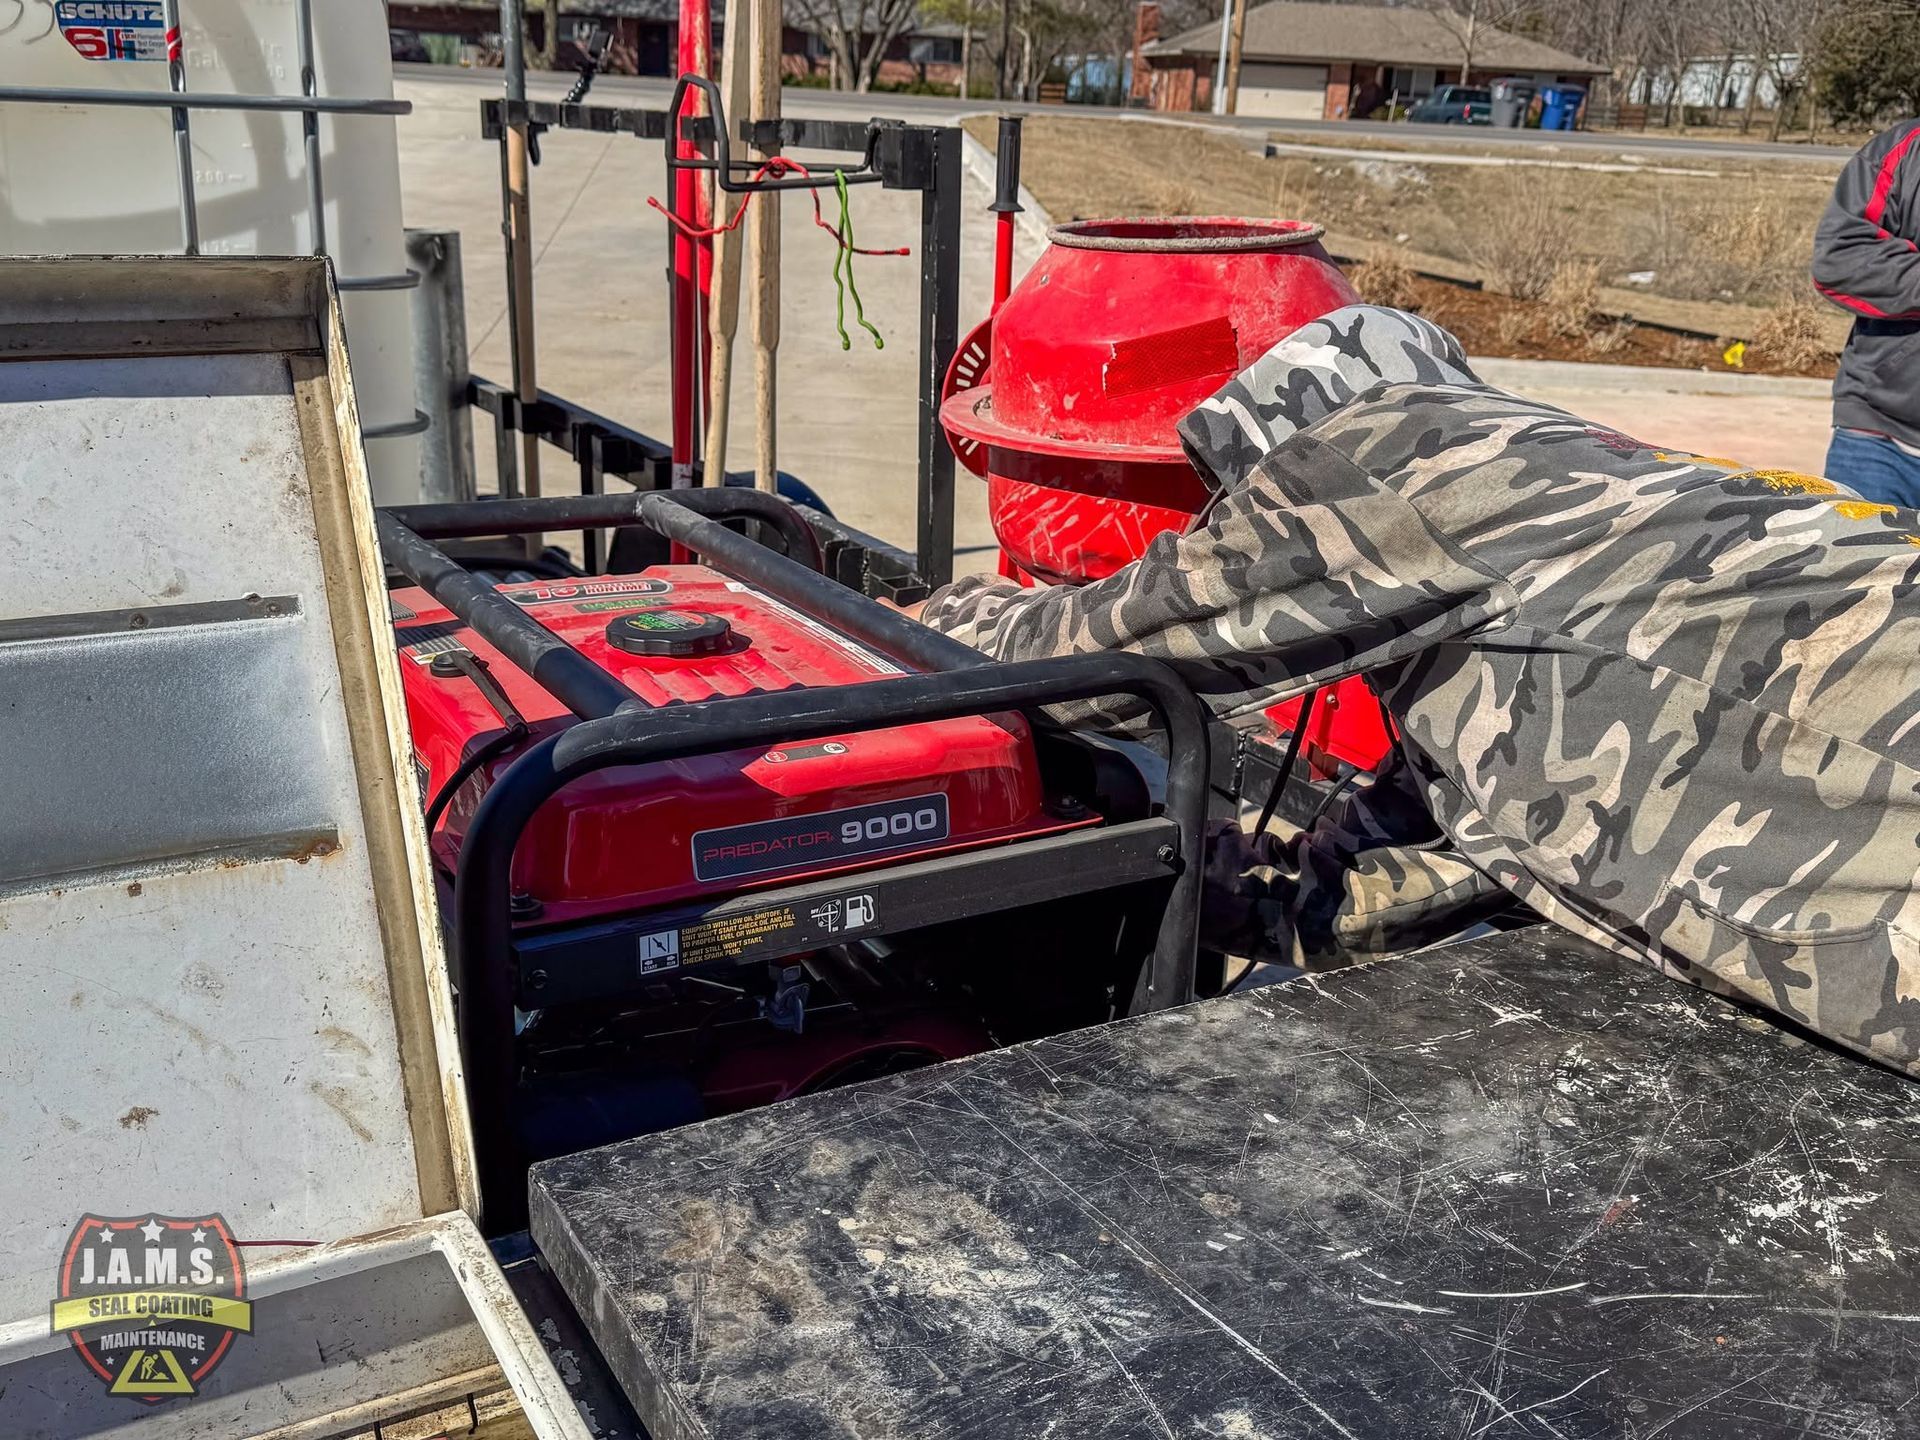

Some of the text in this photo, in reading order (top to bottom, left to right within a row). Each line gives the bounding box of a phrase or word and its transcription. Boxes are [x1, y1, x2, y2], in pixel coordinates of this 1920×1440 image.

[703, 808, 937, 862] PREDATOR 9000
[682, 923, 712, 935] EQUIPPED
[712, 920, 728, 929] WITH
[729, 917, 744, 926] LOW
[682, 933, 696, 941] UNIT
[697, 929, 717, 938] WON'T
[719, 925, 737, 934] START
[739, 921, 759, 931] CHECK
[692, 937, 717, 947] PROPER
[717, 933, 735, 942] LEVEL
[746, 924, 779, 936] WARRANTY
[683, 956, 703, 965] CHECK
[704, 951, 724, 961] SPARK
[690, 948, 703, 957] UNIT
[705, 944, 721, 954] STILL
[722, 940, 742, 949] WON'T
